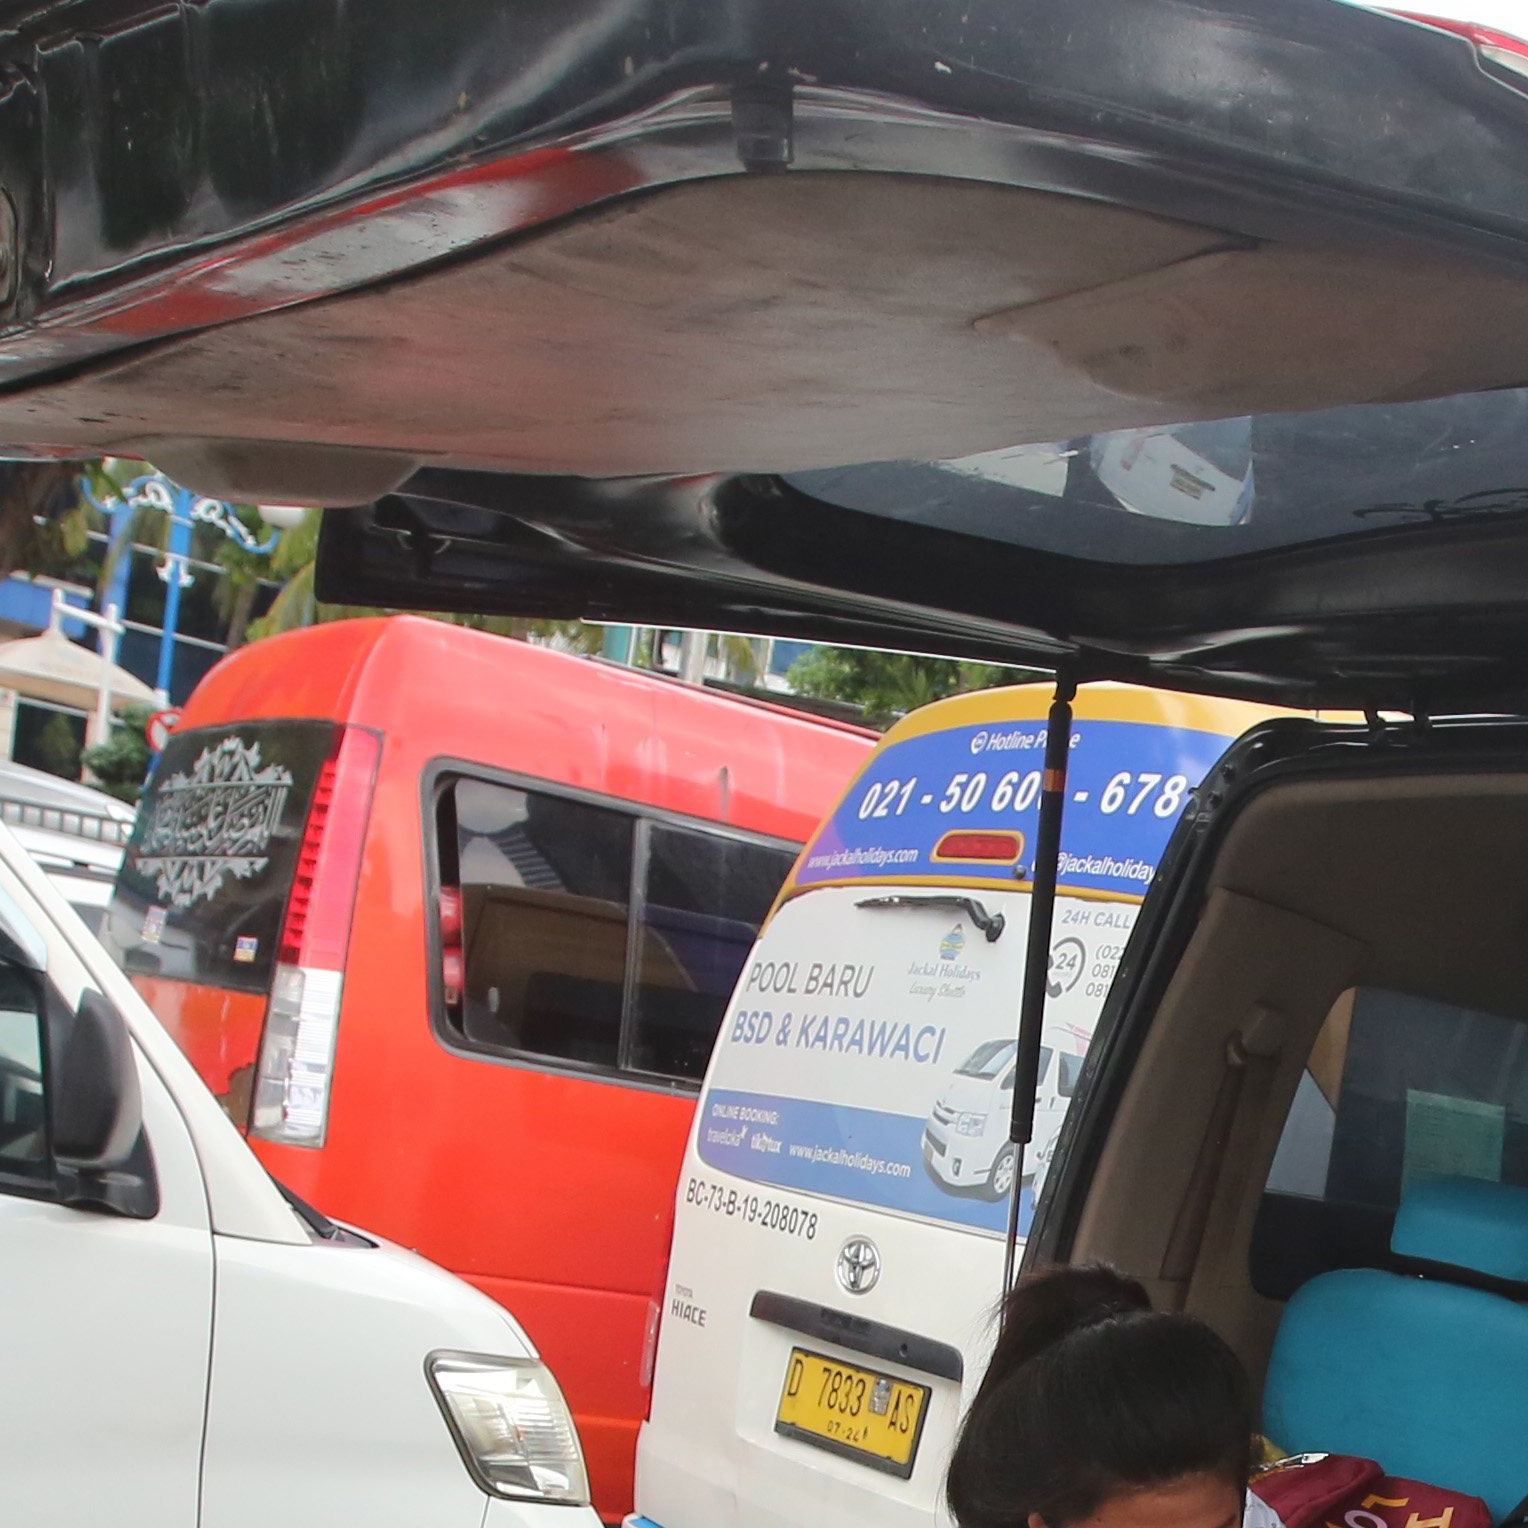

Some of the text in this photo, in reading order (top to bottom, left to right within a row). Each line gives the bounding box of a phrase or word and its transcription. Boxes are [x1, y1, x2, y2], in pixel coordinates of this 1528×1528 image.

[986, 731, 1034, 752] Hotline
[858, 777, 918, 820] 021
[939, 772, 988, 813] 50
[991, 771, 1044, 813] 60
[1100, 771, 1189, 818] 678
[807, 848, 919, 870] www.jackalholidays.com
[1057, 852, 1156, 885] @jackalholiday
[1061, 909, 1132, 929] 24H CALL
[907, 961, 982, 982] Jackal Holidays
[1055, 952, 1078, 970] 24
[1092, 963, 1116, 978] 081
[745, 962, 875, 998] POOL BARU
[1085, 982, 1109, 998] 081
[731, 1010, 947, 1064] BSD & KARAWACI
[712, 1103, 739, 1120] ONLINE
[789, 1143, 912, 1178] www.jackalholidays.com
[686, 1178, 818, 1240] BC-73-B-19-208078
[671, 1298, 707, 1328] HIACE
[788, 1358, 914, 1434] D 7833 AS
